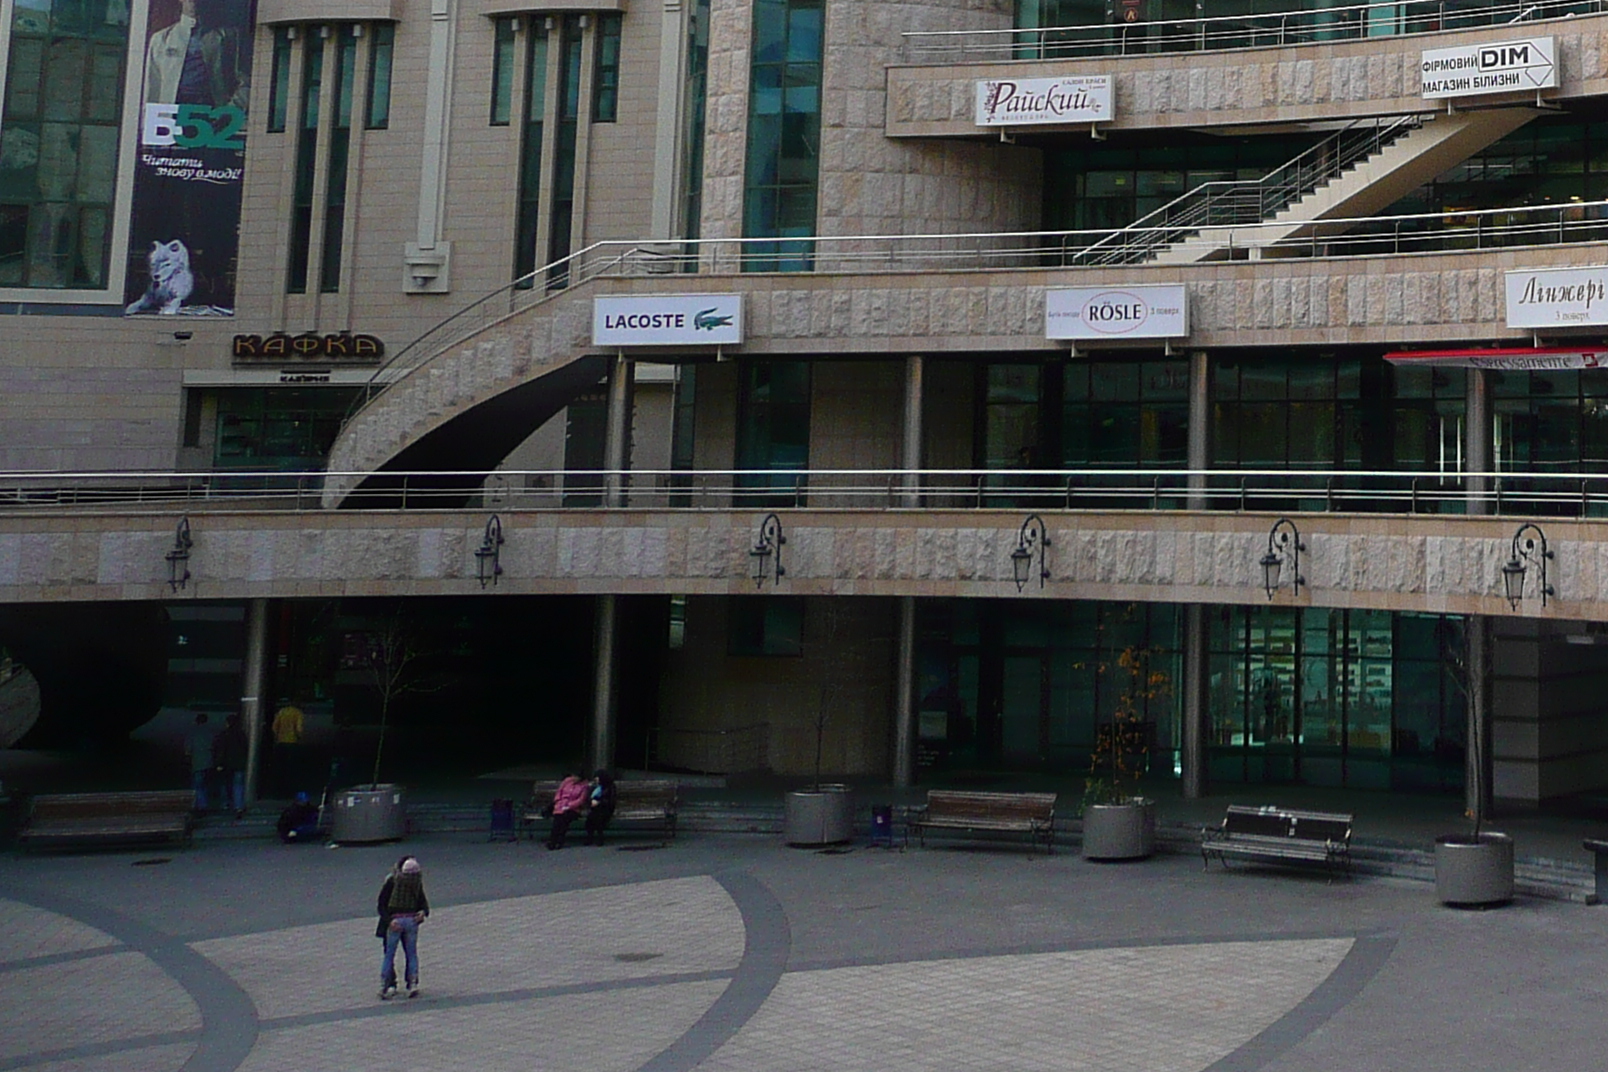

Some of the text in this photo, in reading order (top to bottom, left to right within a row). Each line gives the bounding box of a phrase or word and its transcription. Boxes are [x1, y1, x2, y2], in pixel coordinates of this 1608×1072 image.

[1422, 46, 1529, 72] ФІРМОВИЙ DIM
[1423, 73, 1520, 93] МАГАЗИН БІЛИЗНИ
[991, 82, 1090, 116] Райский
[156, 167, 195, 180] знову
[1518, 276, 1605, 309] Лінжері
[1089, 301, 1142, 321] RÖSLE
[605, 314, 685, 329] LACOSTE
[236, 336, 378, 354] КАФКА
